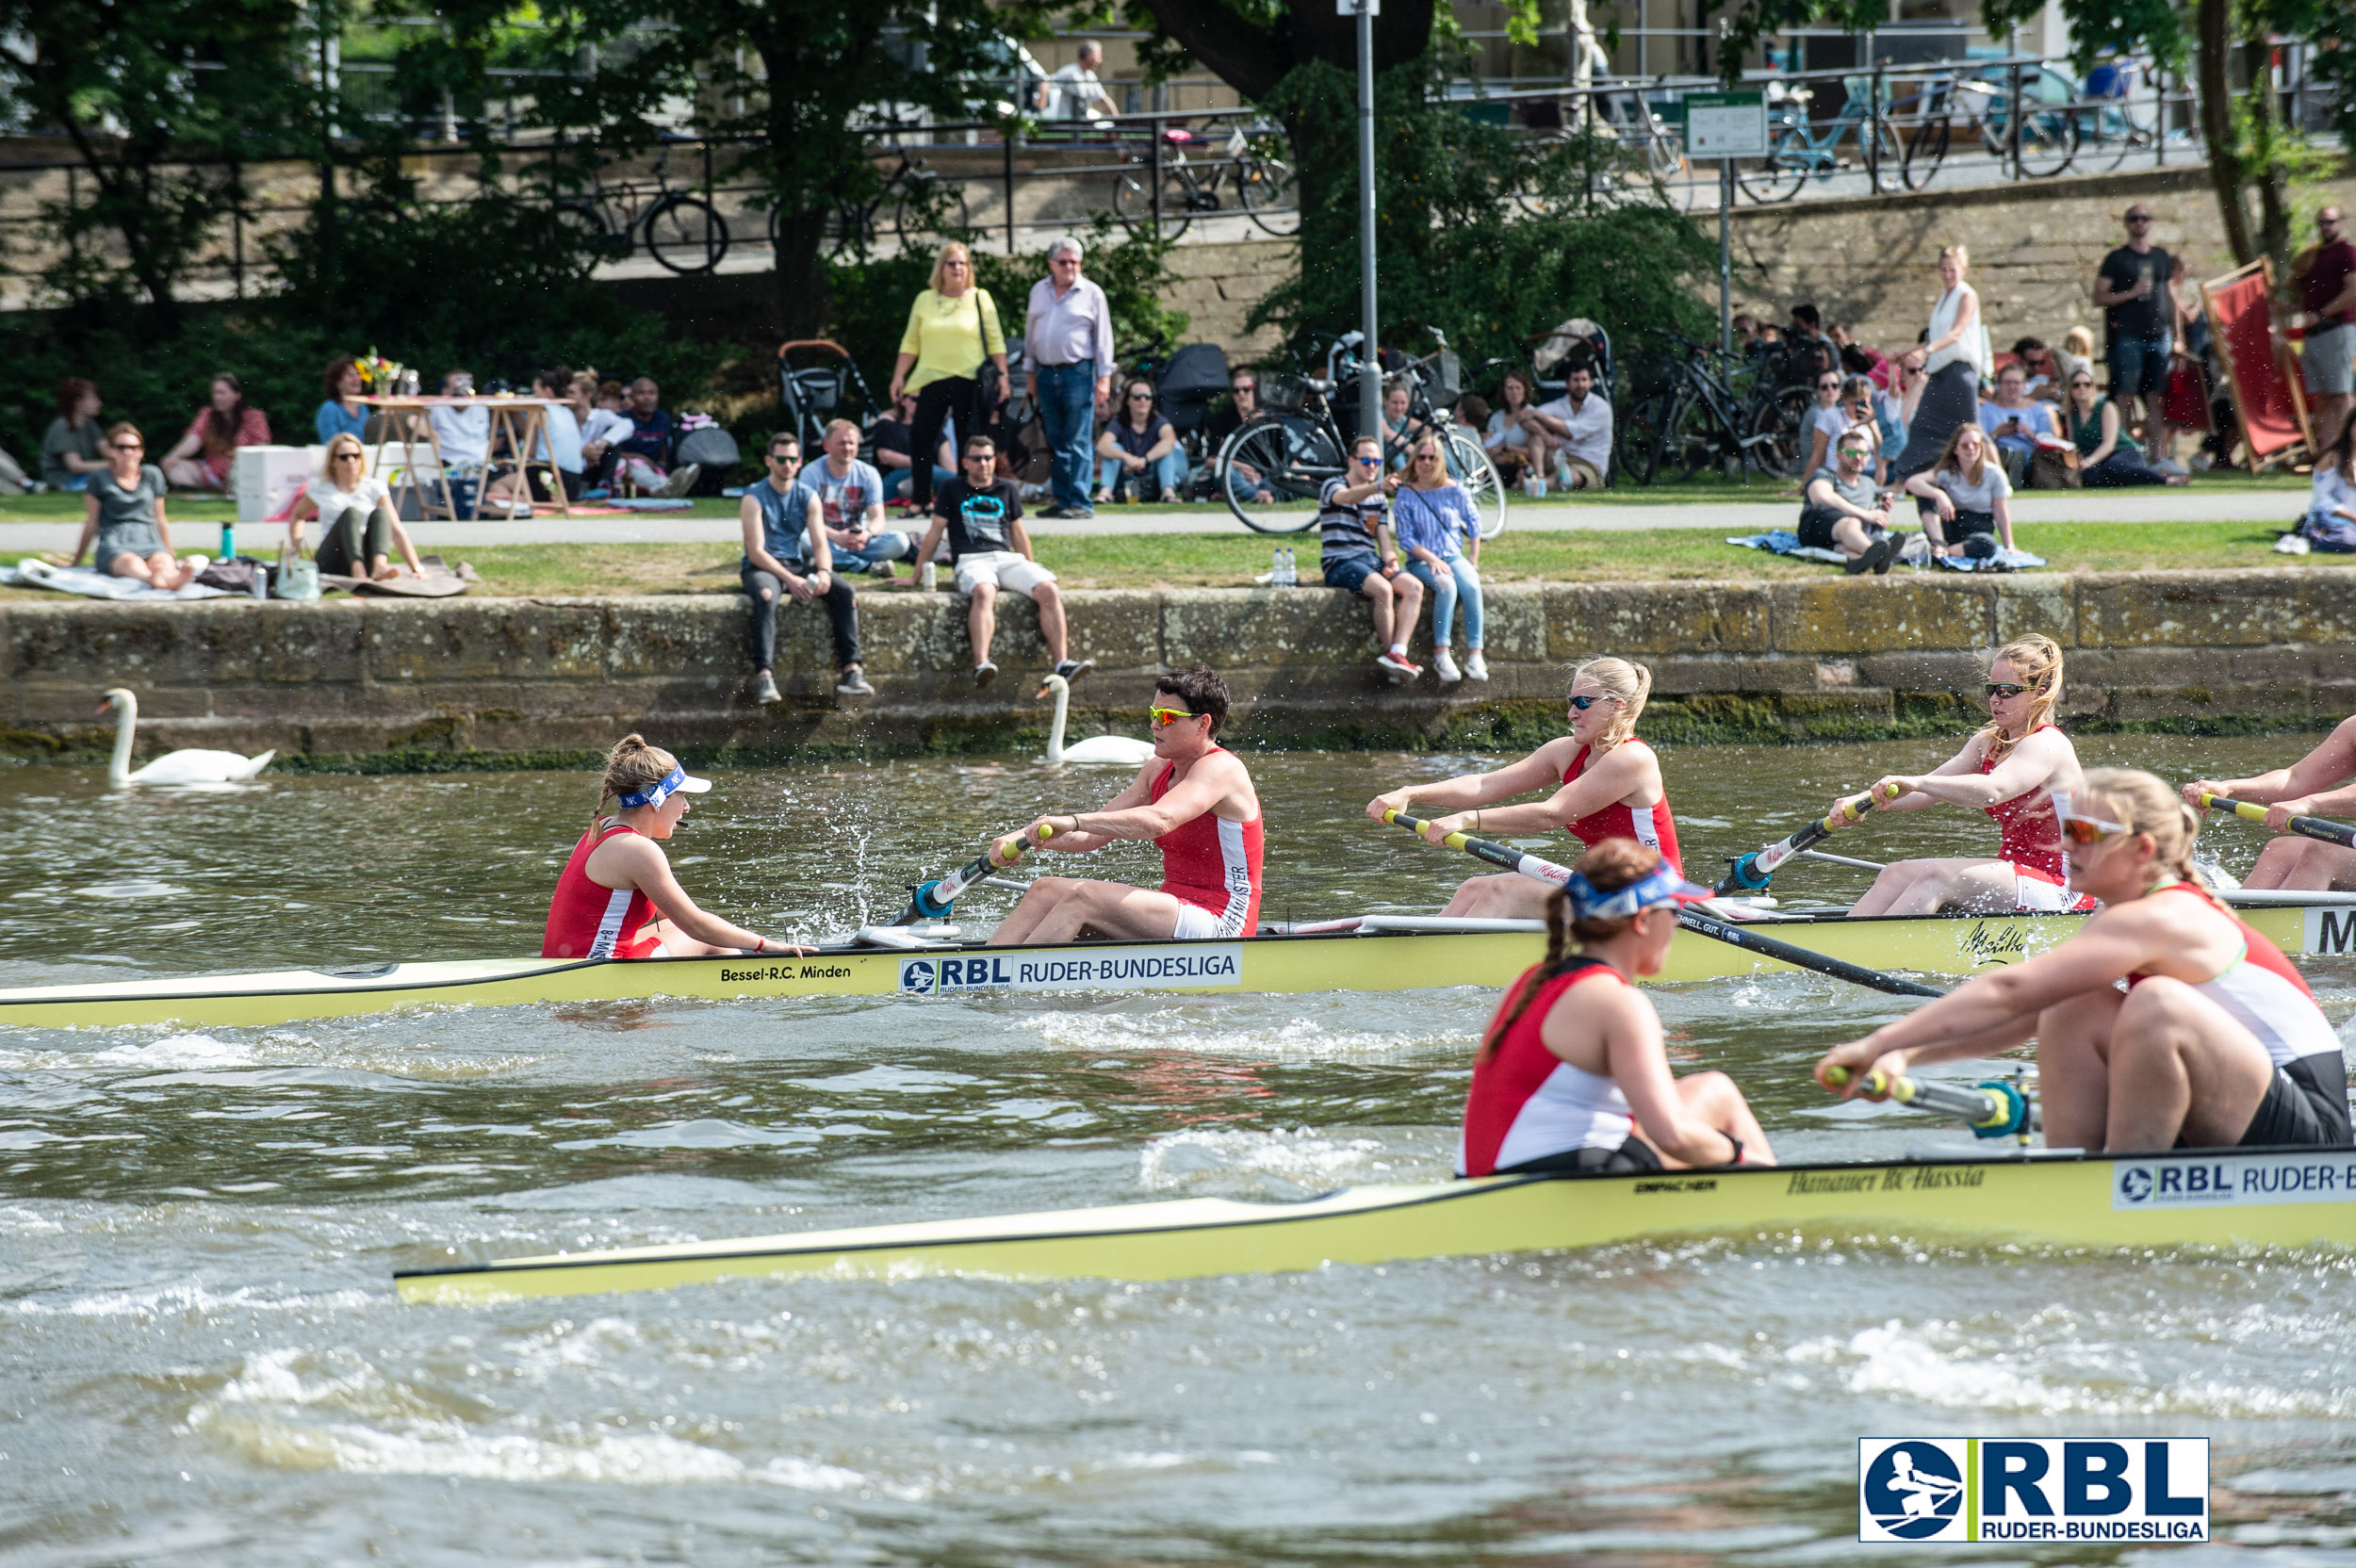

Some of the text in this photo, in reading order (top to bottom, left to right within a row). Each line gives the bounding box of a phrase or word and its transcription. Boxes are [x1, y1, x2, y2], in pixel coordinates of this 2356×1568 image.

[721, 965, 851, 982] Bessel-R.C. Minden
[941, 958, 1011, 986] RBL
[1020, 955, 1235, 983] RUDER-BUNDESLIGA
[2160, 1165, 2233, 1192] RBL
